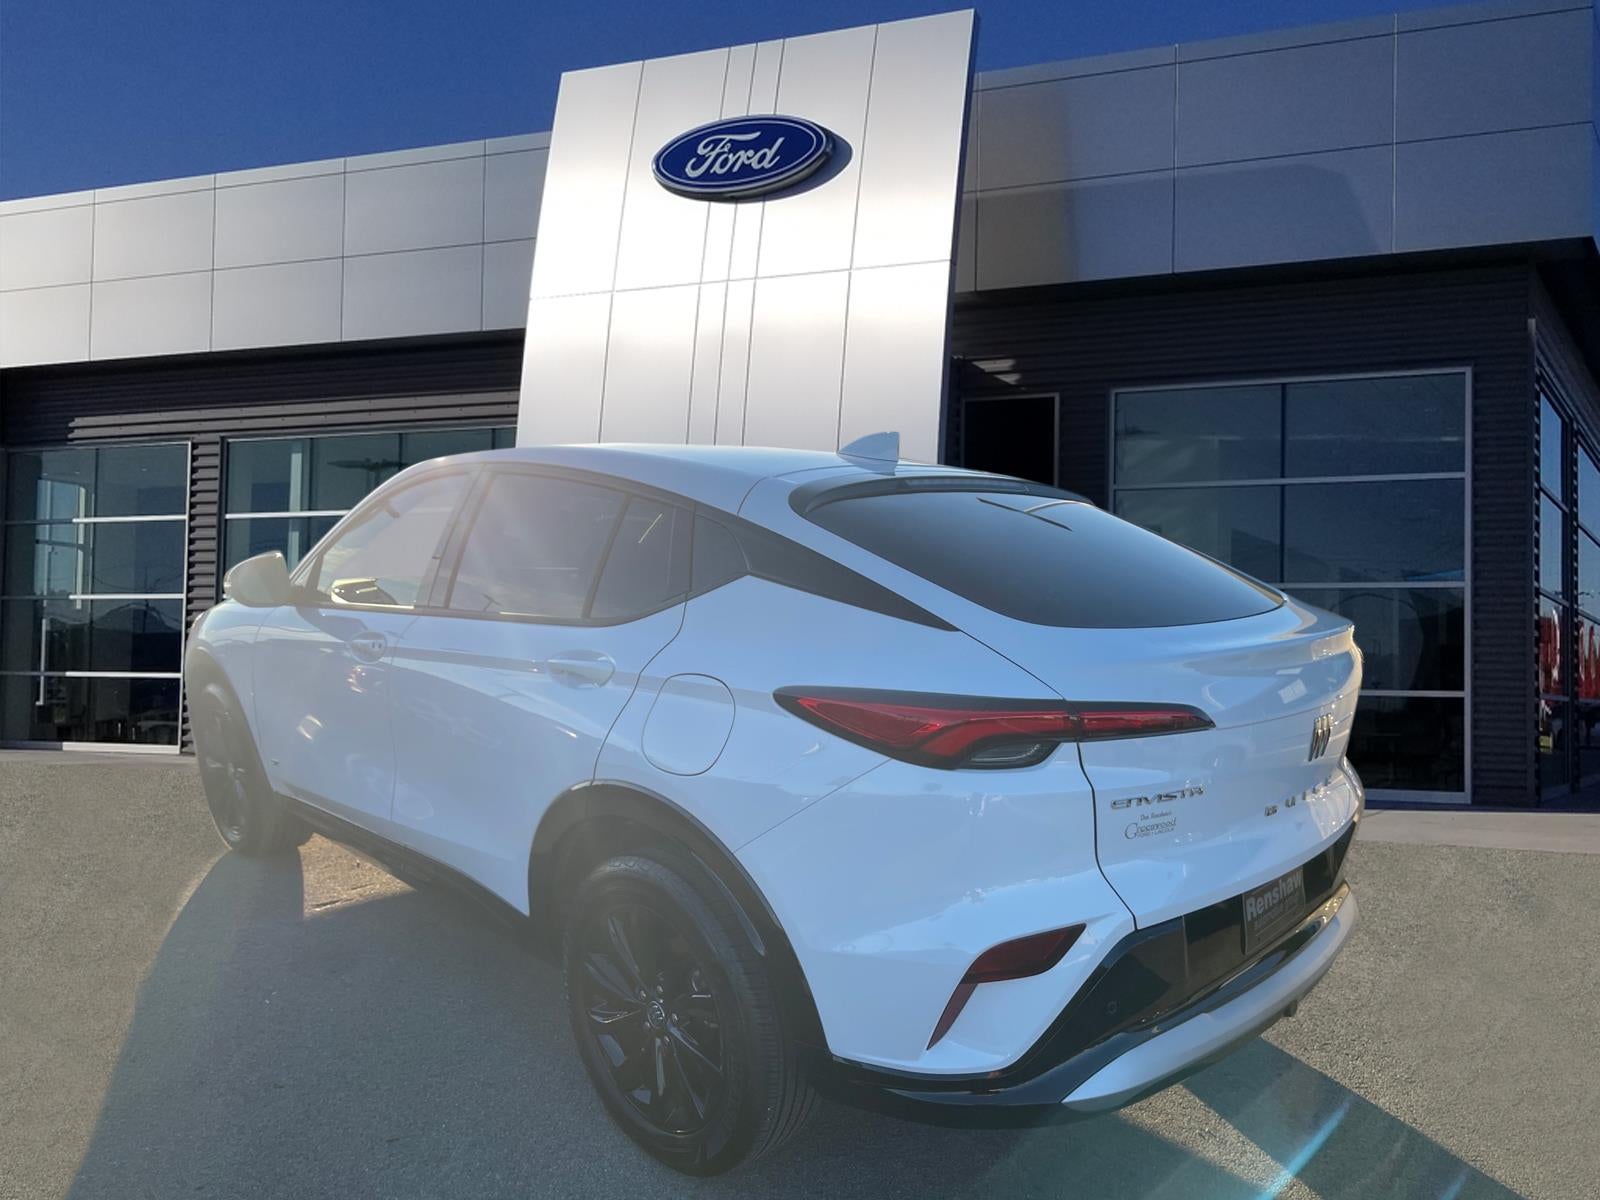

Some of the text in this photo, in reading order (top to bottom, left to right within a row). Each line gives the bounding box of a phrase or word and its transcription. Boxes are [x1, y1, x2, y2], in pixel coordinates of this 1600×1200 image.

[685, 131, 784, 178] Ford
[1110, 787, 1204, 810] ENVISTA
[1246, 868, 1303, 922] Renshaw
